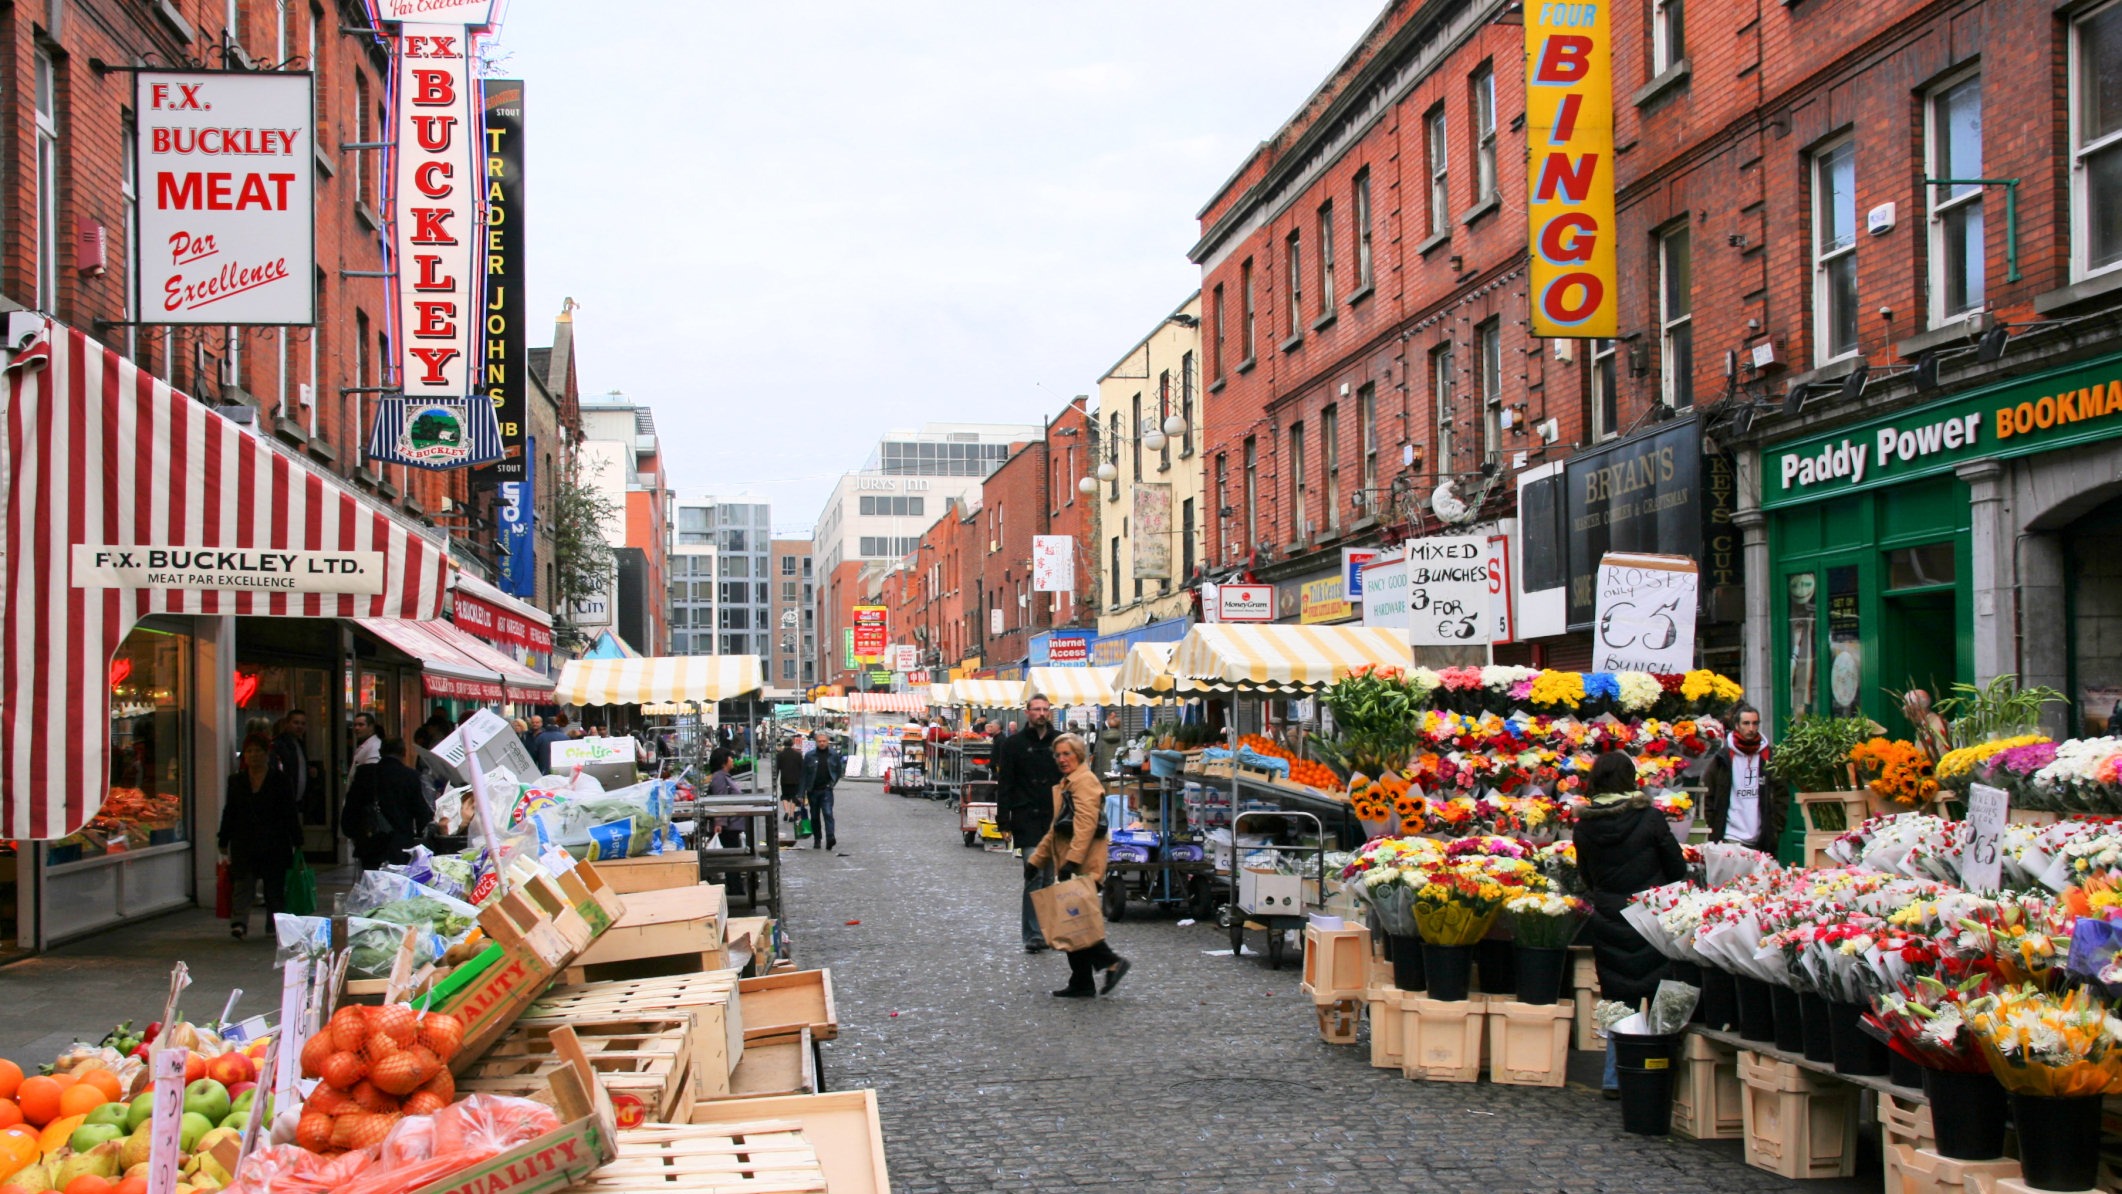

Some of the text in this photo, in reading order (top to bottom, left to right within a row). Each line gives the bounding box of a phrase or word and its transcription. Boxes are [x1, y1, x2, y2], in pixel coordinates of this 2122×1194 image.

[1539, 2, 1598, 27] FOUR
[404, 36, 463, 58] F.X.
[151, 83, 212, 111] F.X.
[496, 108, 520, 117] STOUT
[151, 127, 302, 156] BUCKLEY
[157, 172, 296, 211] MEAT
[1531, 34, 1604, 327] BINGO
[487, 128, 506, 275] TRADER
[409, 70, 461, 386] BUCKLEY
[169, 231, 217, 266] Par
[164, 257, 287, 311] Excellence
[487, 286, 506, 408] JOHNS
[1781, 380, 2122, 490] Paddy Power BOOKMA
[415, 447, 465, 458] BUCKLEY
[497, 464, 521, 473] STOUT
[1584, 446, 1675, 504] BRYAN'S
[1711, 458, 1733, 585] KEYS CUT
[96, 551, 365, 574] F.X. BUCKLEY LTD.
[1412, 566, 1488, 585] BUNCHES
[148, 573, 296, 588] MEAT PAR EXCELLENCE
[1368, 578, 1385, 593] FANCY
[1604, 587, 1634, 598] ONLY
[577, 600, 606, 614] CITY
[1373, 601, 1406, 617] HARDWARE
[1411, 588, 1464, 616] 3 FOR
[1437, 612, 1478, 639] €5
[1049, 638, 1086, 648] Internet
[1050, 648, 1086, 658] Access
[1737, 789, 1760, 797] FORU
[453, 960, 526, 1026] ALITY
